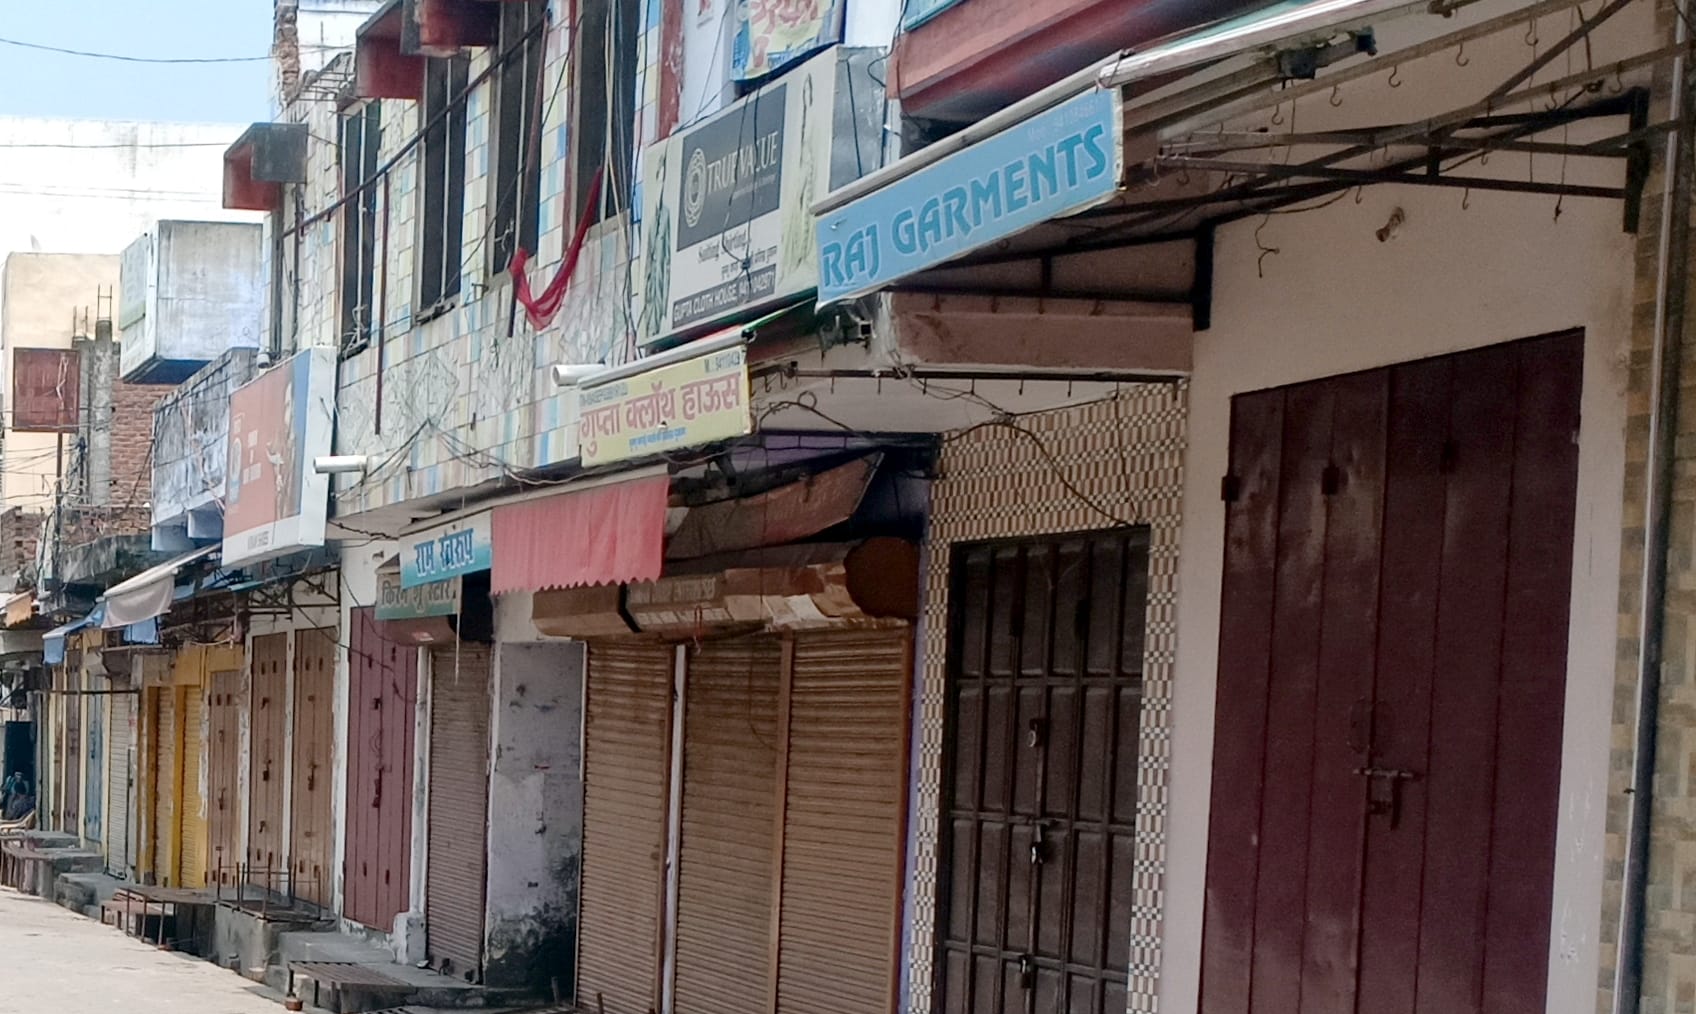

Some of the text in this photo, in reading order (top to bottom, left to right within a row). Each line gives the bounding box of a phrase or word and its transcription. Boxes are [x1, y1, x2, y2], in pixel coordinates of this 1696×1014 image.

[821, 224, 880, 288] RAJ
[892, 124, 1105, 255] GARMENTS
[580, 403, 622, 457] गुप्ता
[626, 380, 677, 430] क्लॉथ
[680, 372, 742, 421] हाऊस
[414, 540, 436, 577] राम
